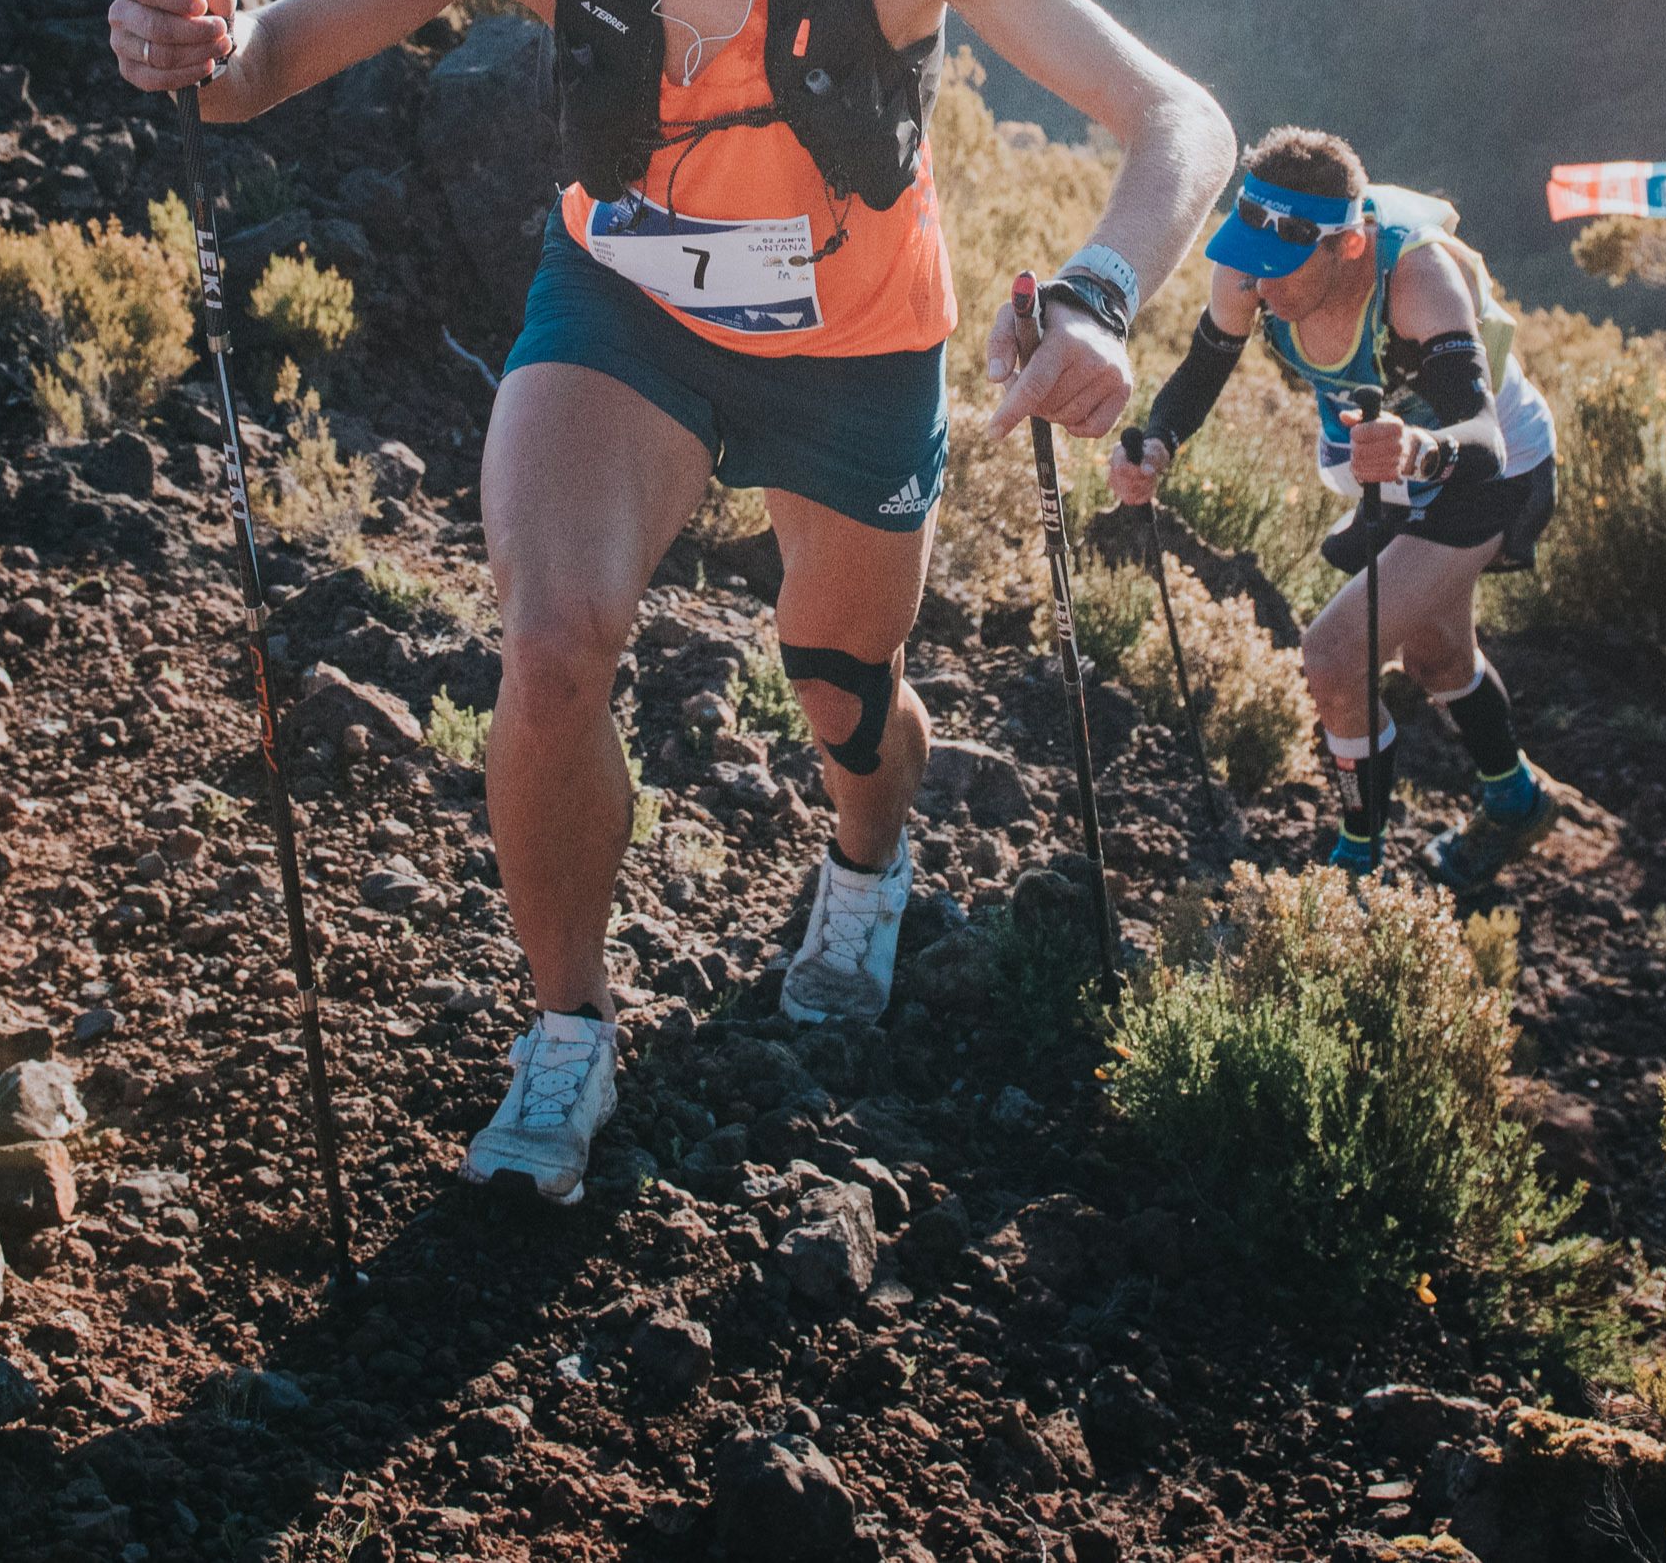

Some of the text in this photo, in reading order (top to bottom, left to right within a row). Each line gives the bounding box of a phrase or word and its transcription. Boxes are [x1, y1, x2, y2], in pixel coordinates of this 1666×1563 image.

[592, 5, 629, 34] TERREX
[196, 229, 223, 310] LEKI
[682, 245, 711, 290] 7
[748, 243, 807, 253] SANTANA
[223, 442, 250, 520] LEKI
[878, 498, 929, 515] adidas
[1040, 485, 1061, 532] LEKI
